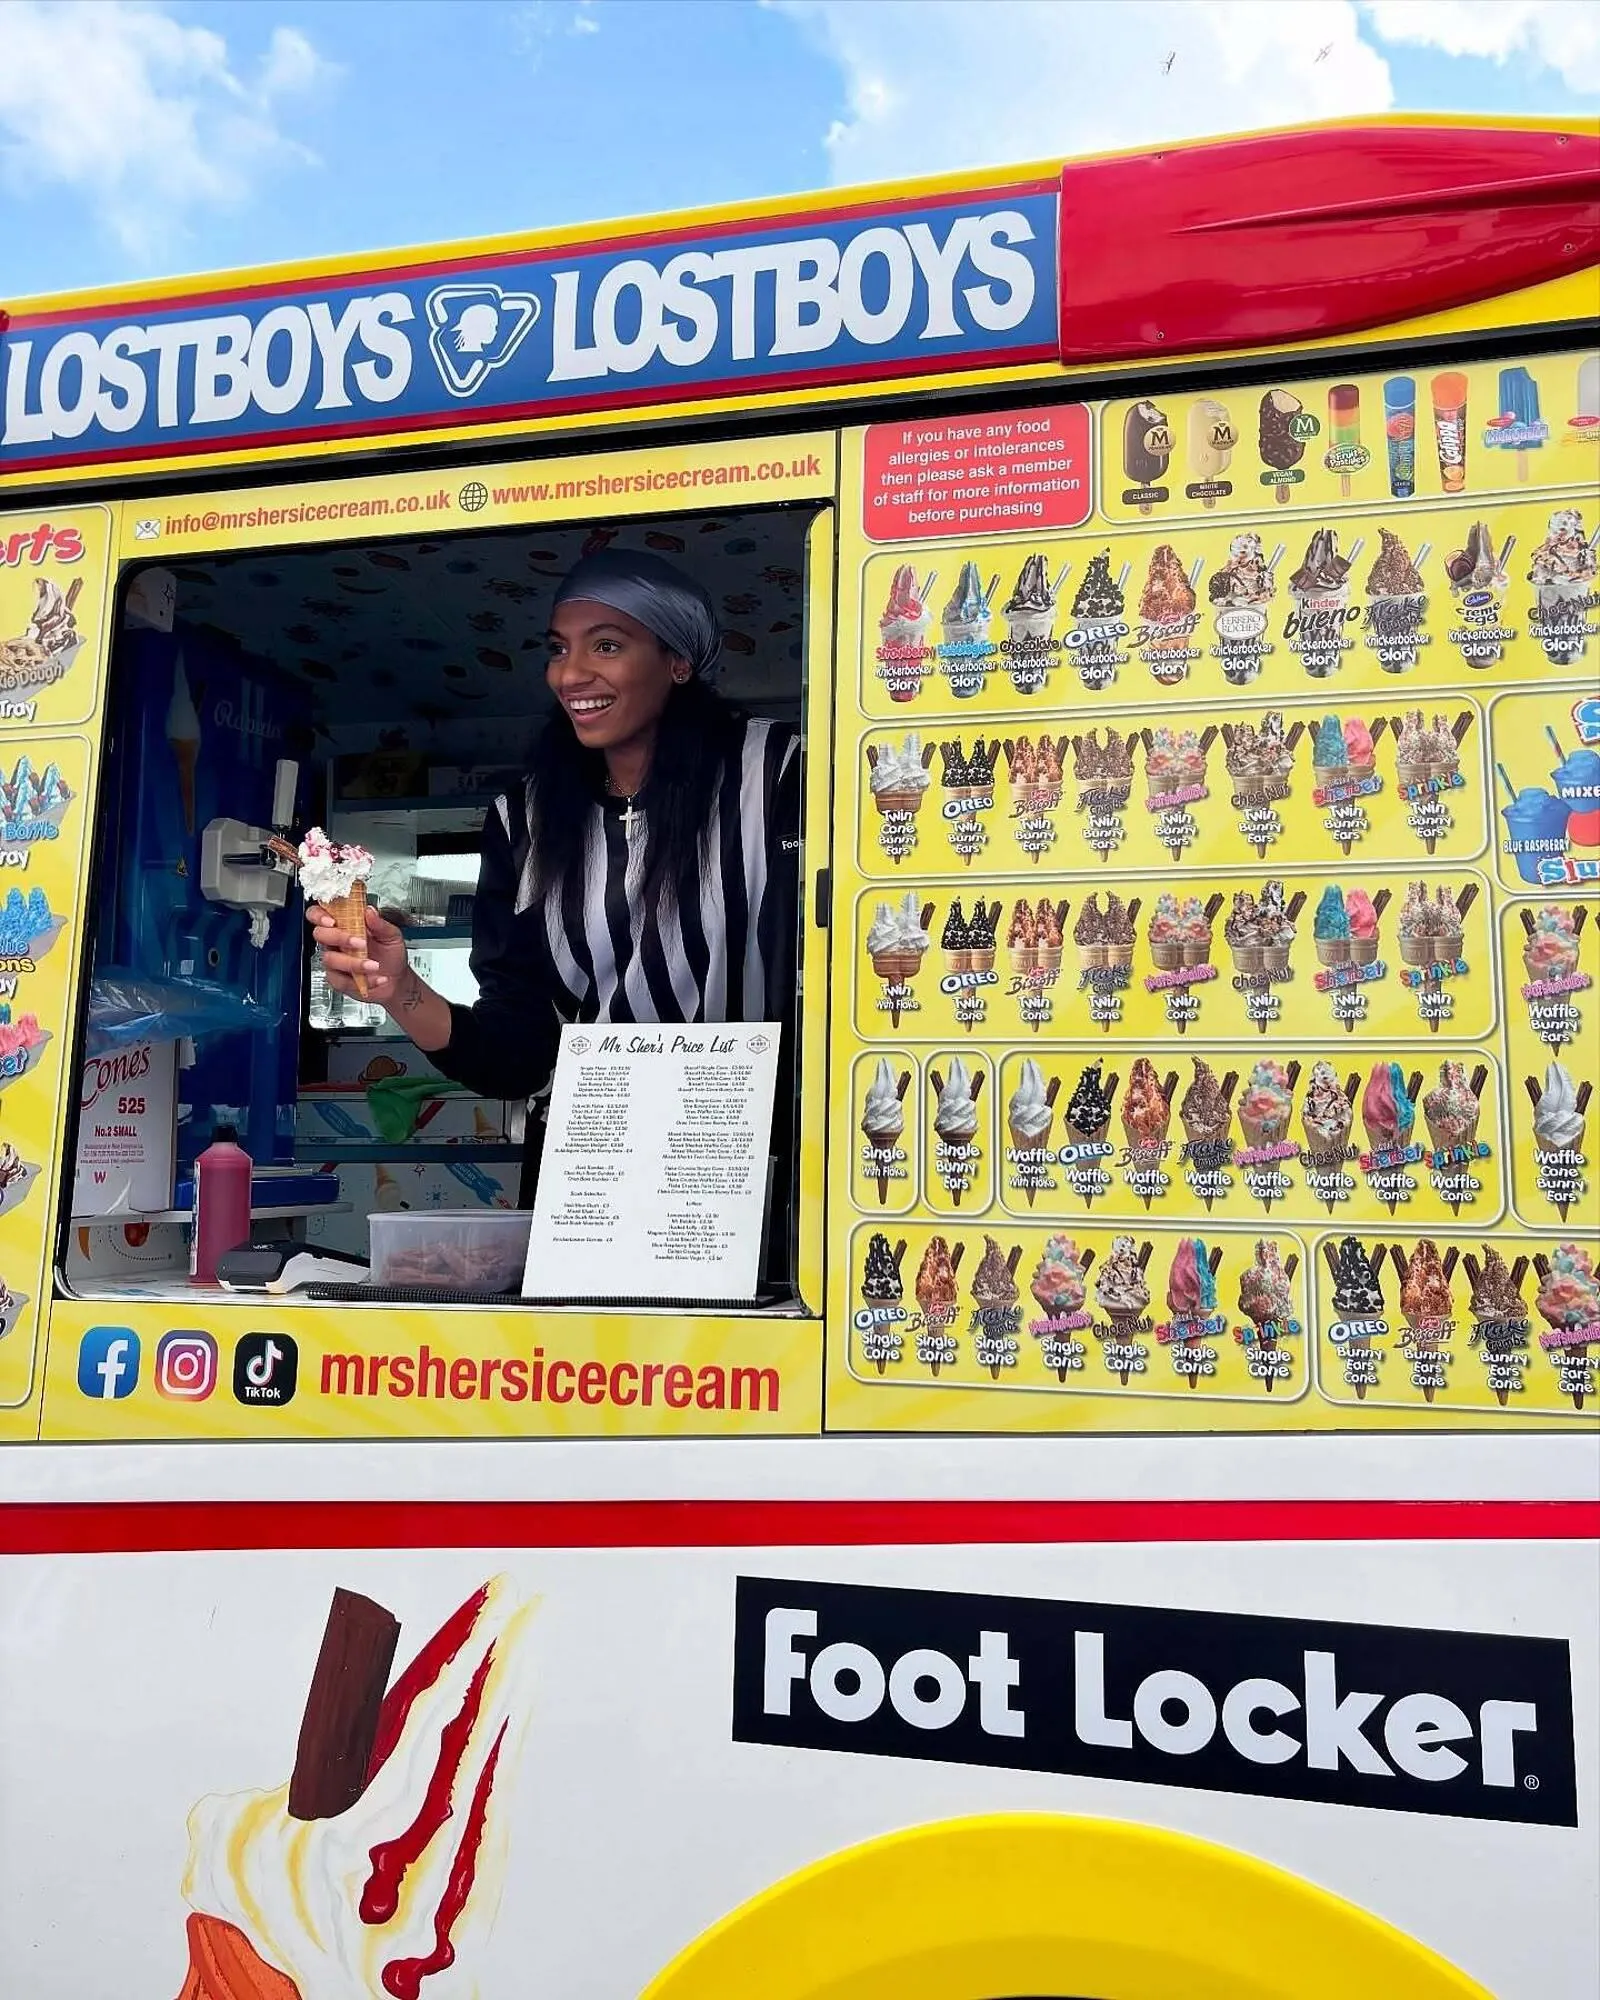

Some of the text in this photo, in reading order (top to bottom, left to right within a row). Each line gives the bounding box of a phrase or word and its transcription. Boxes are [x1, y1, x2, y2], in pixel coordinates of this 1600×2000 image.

[547, 210, 1036, 383] LOSTBOYS
[2, 292, 415, 446] LOSTBOYS
[903, 419, 1050, 447] If you have any food
[888, 448, 949, 466] allergies
[954, 449, 969, 459] or
[492, 456, 821, 504] www.mrshersicecream.co.uk
[881, 458, 1072, 486] then please ask a member
[874, 477, 1080, 506] of staff for more information
[164, 485, 451, 536] info@mrshersicecream.co.uk
[908, 502, 1043, 523] before purchasing
[1283, 607, 1360, 639] bueno
[1065, 624, 1129, 647] OREO
[1542, 635, 1584, 653] Glory
[1376, 648, 1416, 664] Glory
[1461, 641, 1500, 659] Glory
[1221, 656, 1259, 673] Glory
[1300, 650, 1339, 668] Glory
[1011, 669, 1046, 685] Glory
[1080, 665, 1114, 681] Glory
[1150, 661, 1188, 676] Glory
[887, 678, 921, 693] Glory
[949, 675, 983, 690] Glory
[943, 797, 993, 818] OREO
[940, 971, 998, 993] OREO
[626, 1033, 664, 1054] Sher's
[671, 1036, 704, 1054] Price
[710, 1035, 739, 1053] List
[118, 1097, 145, 1114] 525
[113, 1126, 137, 1137] SMALL
[862, 1147, 906, 1161] Single
[935, 1144, 980, 1157] Single
[1006, 1148, 1056, 1162] Waffle
[1060, 1141, 1113, 1163] OREO
[1534, 1151, 1584, 1165] Waffle
[1065, 1170, 1109, 1183] Waffle
[1305, 1174, 1354, 1187] Waffle
[1367, 1174, 1416, 1188] Waffle
[1430, 1175, 1479, 1189] Waffle
[855, 1308, 907, 1329] OREO
[862, 1333, 902, 1346] Single
[1329, 1320, 1388, 1343] OREO
[915, 1335, 956, 1348] Single
[1103, 1342, 1146, 1357] Single
[1246, 1348, 1290, 1362] Single
[321, 1346, 780, 1413] mrshersicecream
[245, 1386, 281, 1399] TikTok
[1075, 1630, 1537, 1788] Locker
